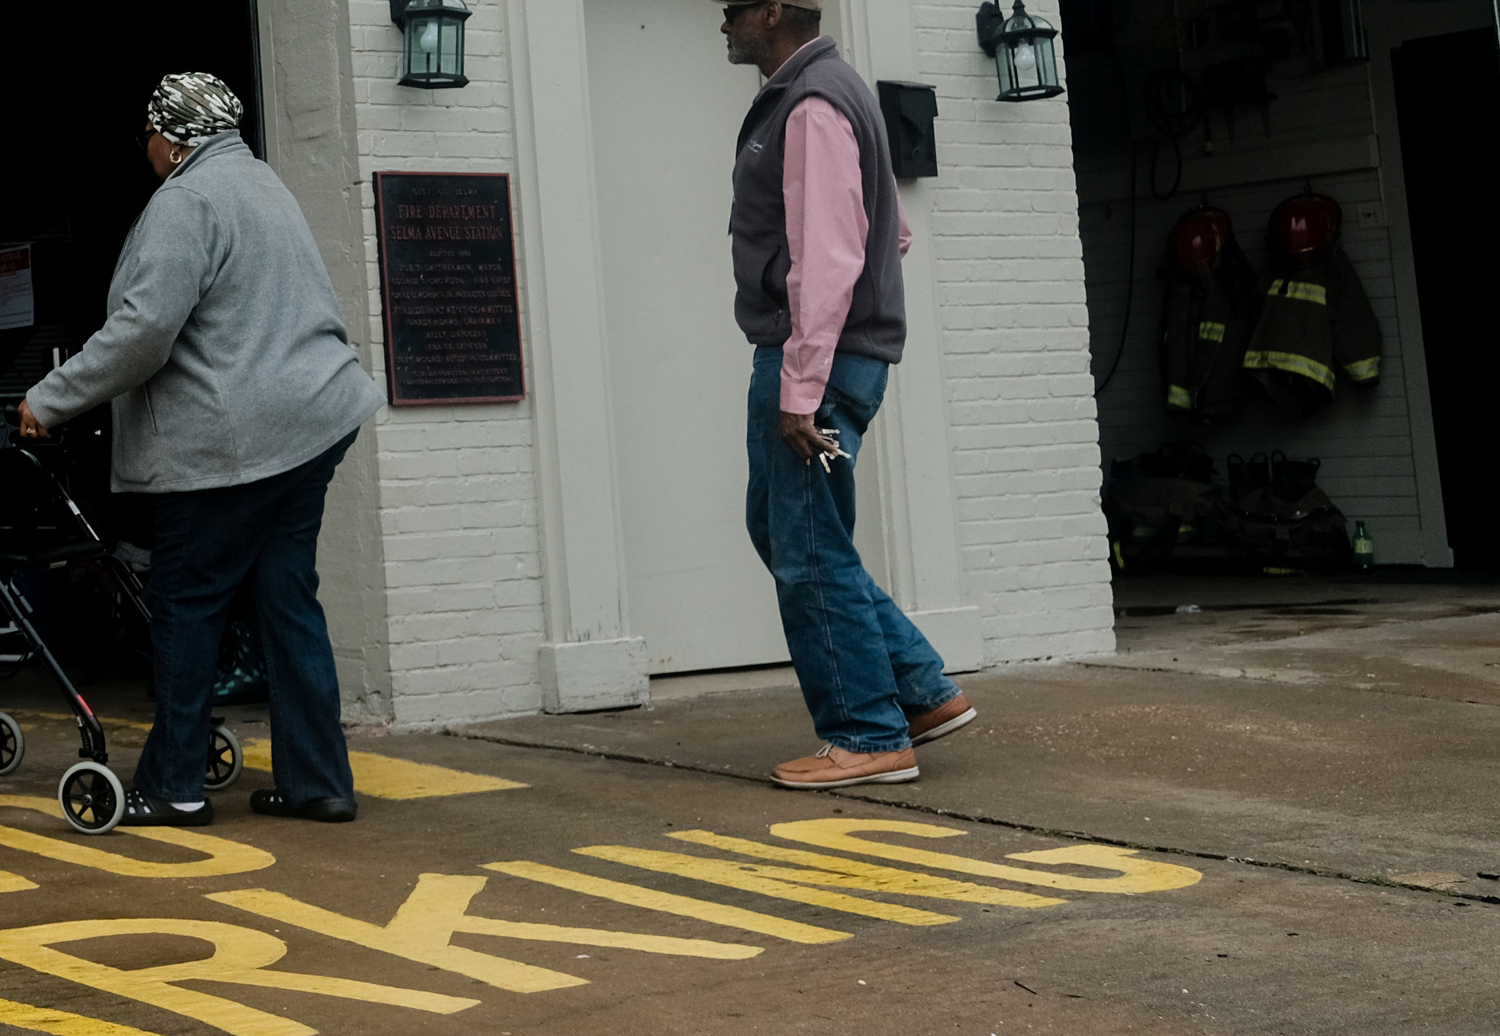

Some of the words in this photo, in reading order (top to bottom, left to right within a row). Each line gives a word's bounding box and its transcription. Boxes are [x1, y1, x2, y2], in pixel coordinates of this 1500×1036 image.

[398, 204, 422, 218] FIRE
[428, 203, 495, 219] DEPARTMENT
[390, 226, 421, 239] SELMA
[424, 226, 461, 239] AVENUE
[464, 225, 502, 239] STATION
